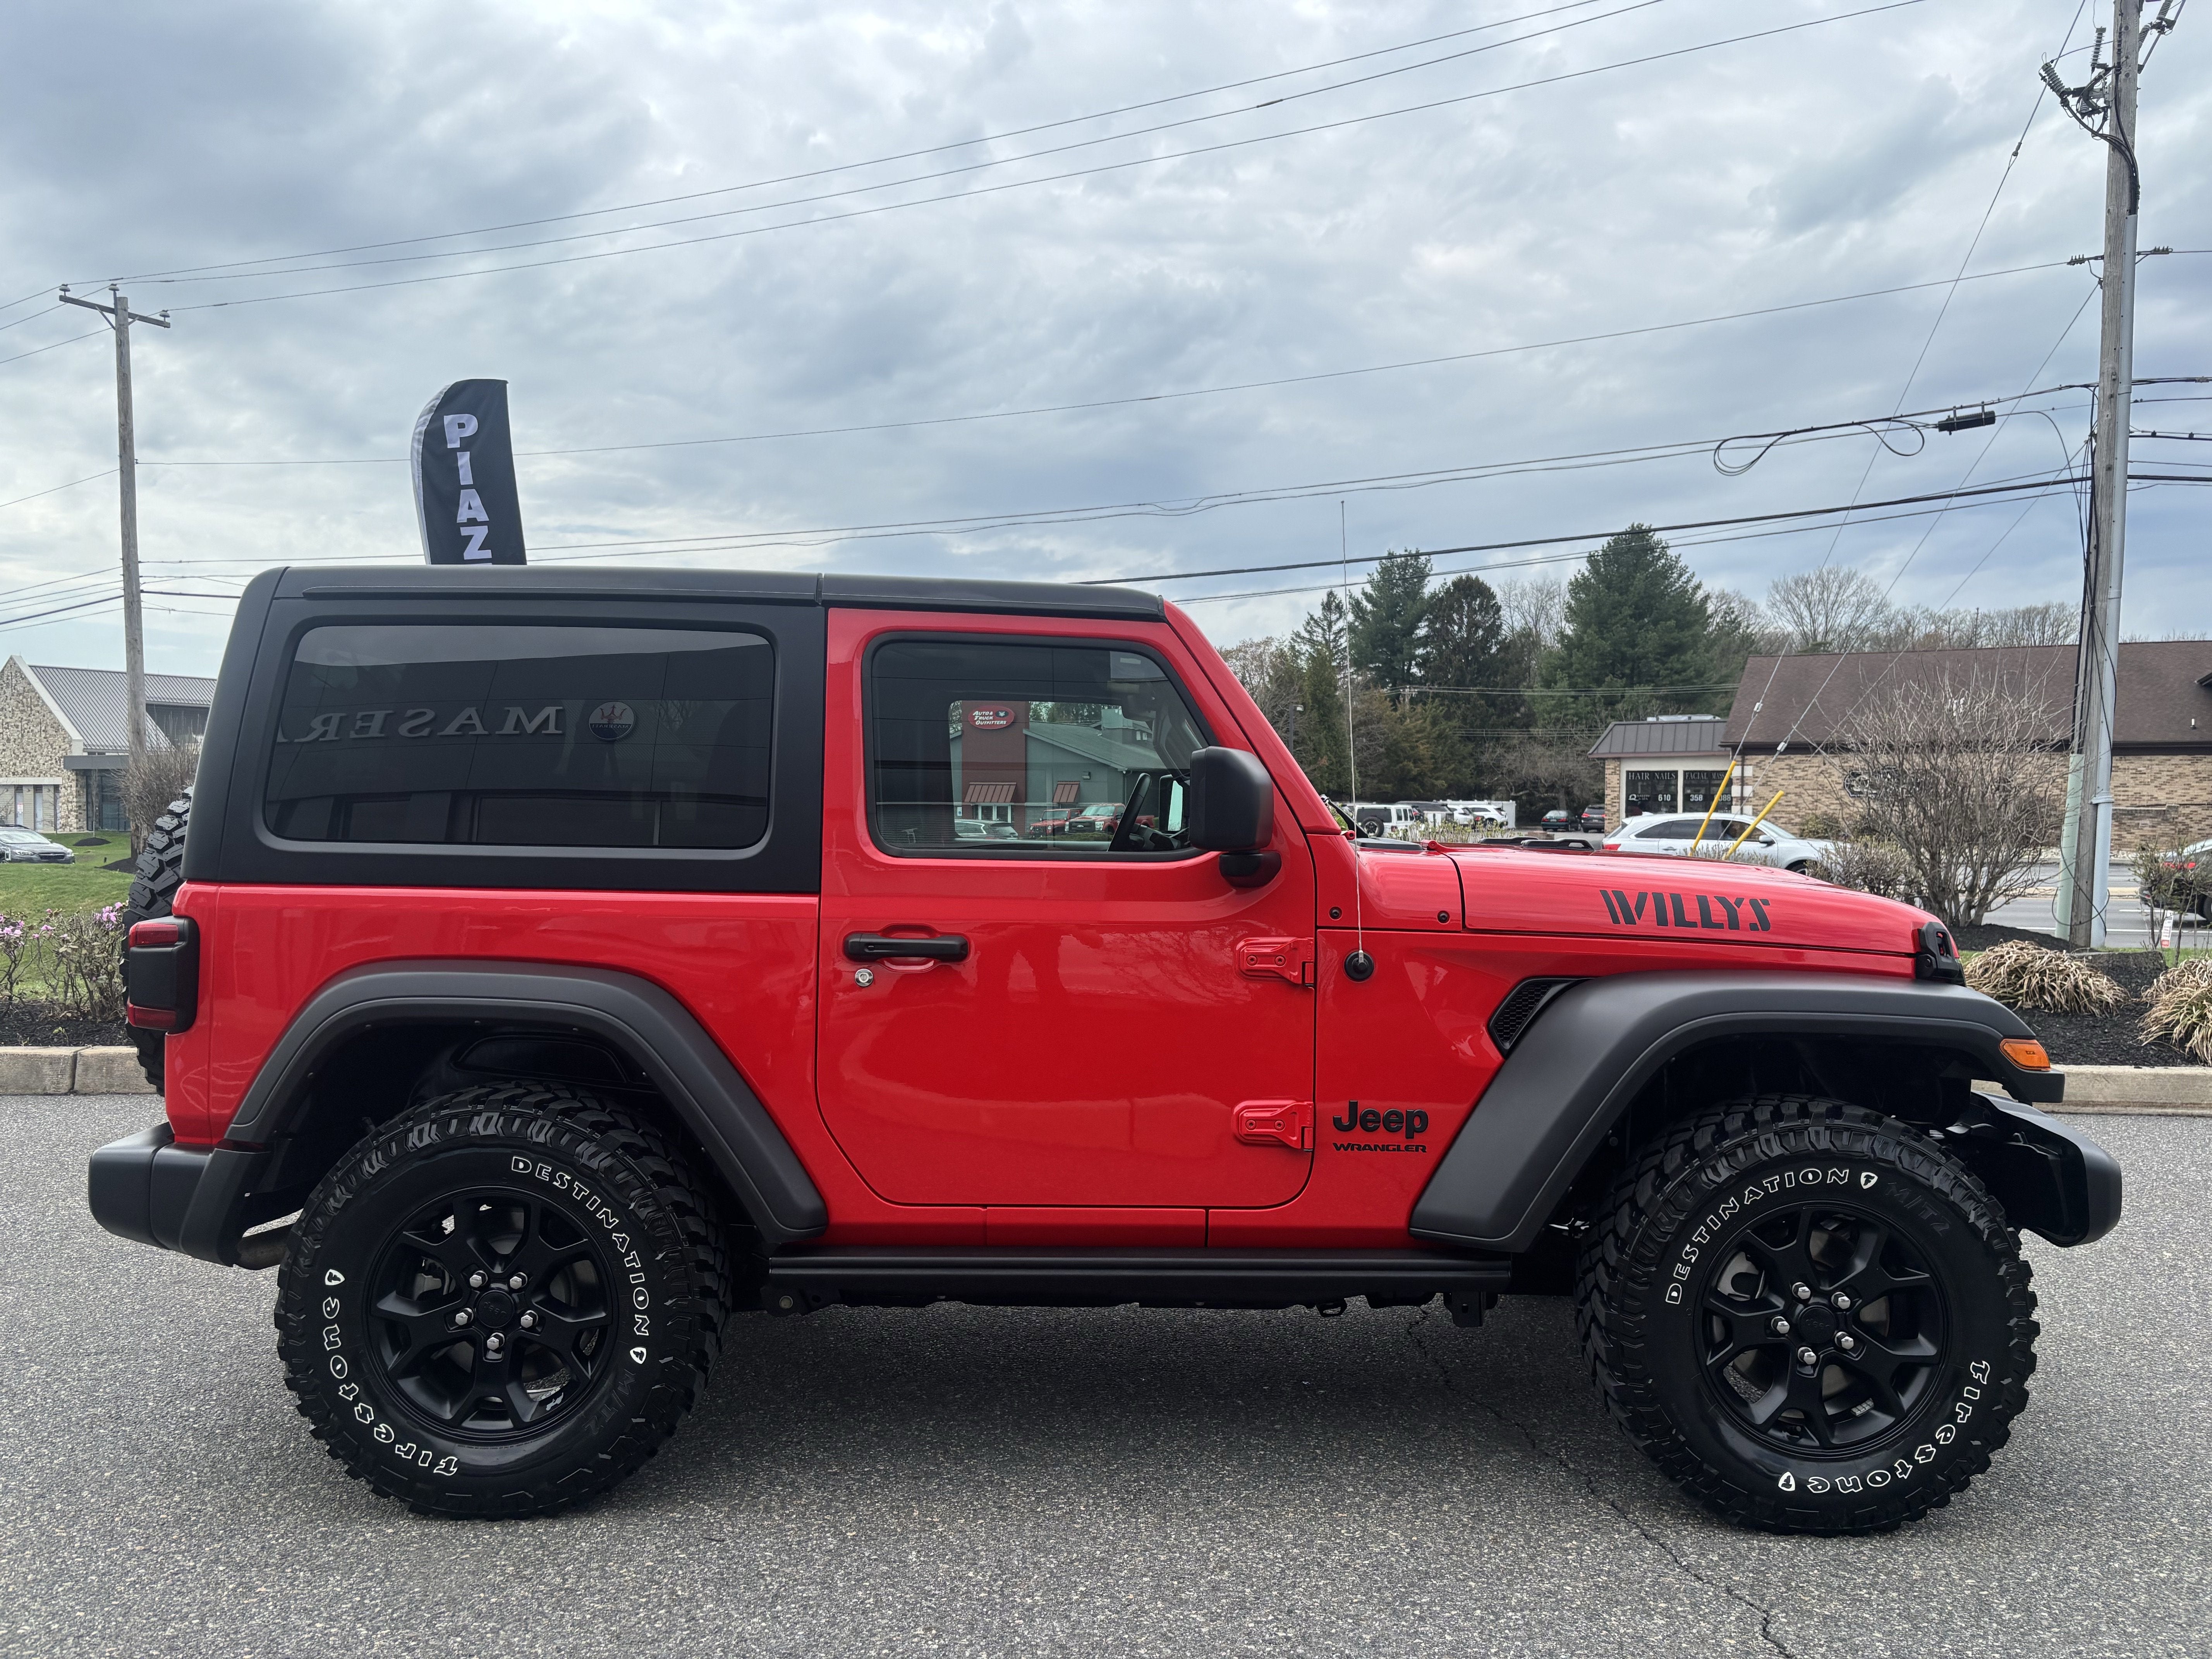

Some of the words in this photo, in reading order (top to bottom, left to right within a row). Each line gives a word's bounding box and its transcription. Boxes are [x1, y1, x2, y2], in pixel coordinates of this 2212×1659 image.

[443, 414, 493, 565] PIAZ
[1599, 890, 1771, 931] WILLYS
[1332, 1142, 1427, 1153] WRANGLER
[1333, 1099, 1429, 1139] Jeep
[511, 1156, 650, 1336] DESTINATION
[1665, 1168, 1849, 1305] DESTINATION
[323, 1297, 458, 1476] Firestone
[1807, 1360, 1990, 1494] Firestone
